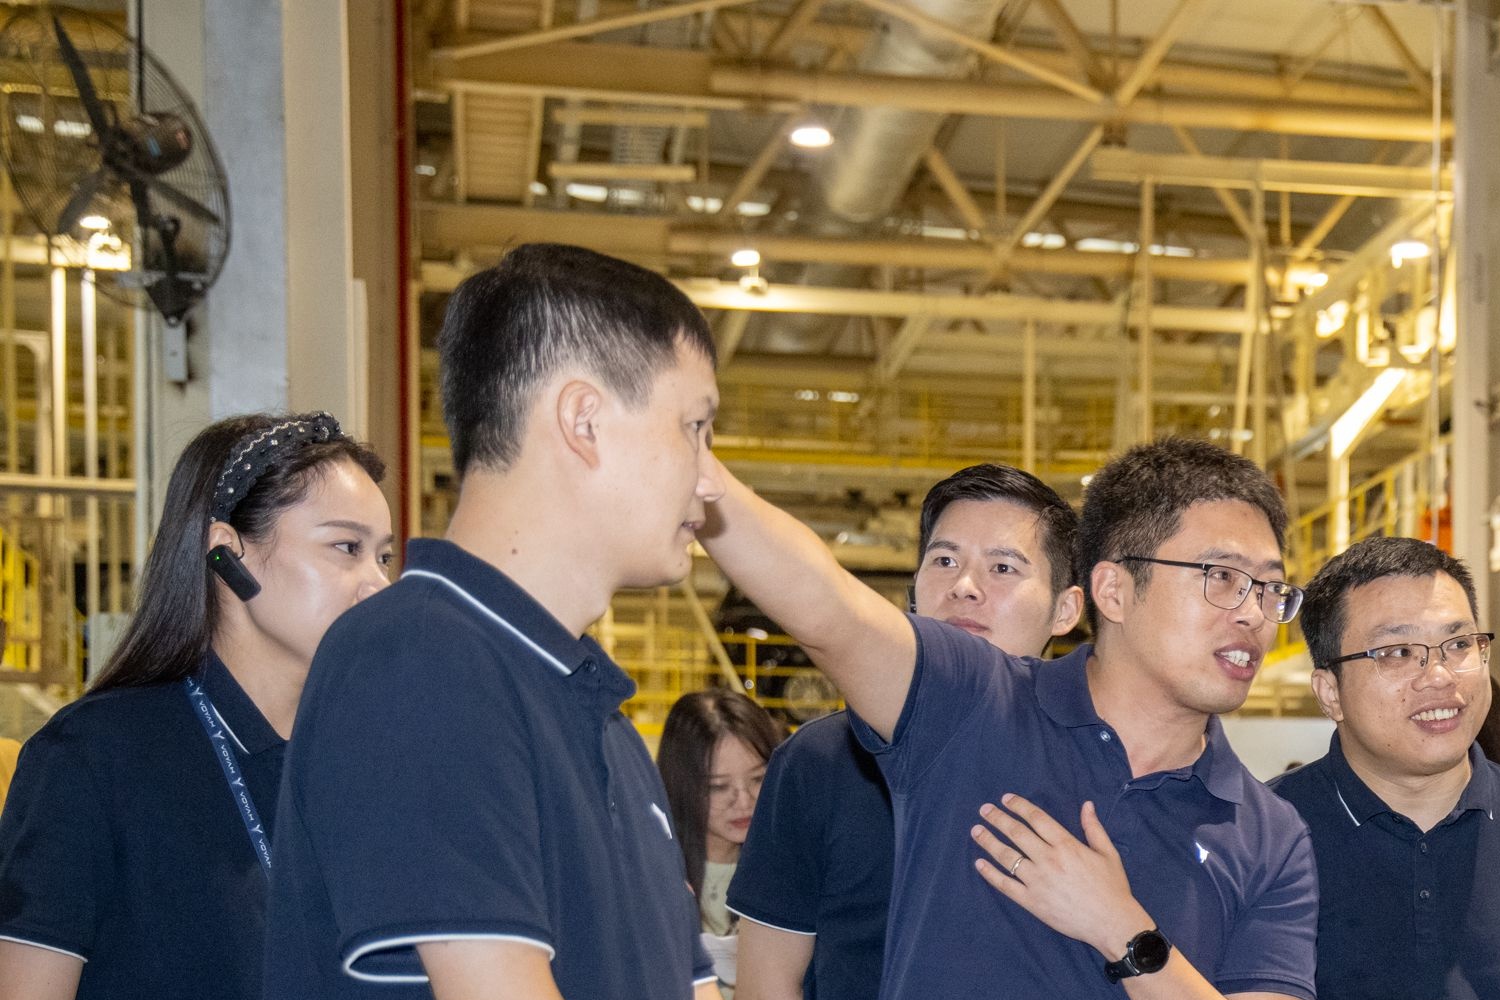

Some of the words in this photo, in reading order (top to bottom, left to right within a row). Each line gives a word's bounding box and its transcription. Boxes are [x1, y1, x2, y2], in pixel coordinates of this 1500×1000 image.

[199, 700, 216, 728] VOYAH
[221, 744, 236, 774] VOYAH
[240, 791, 255, 821] VOYAH
